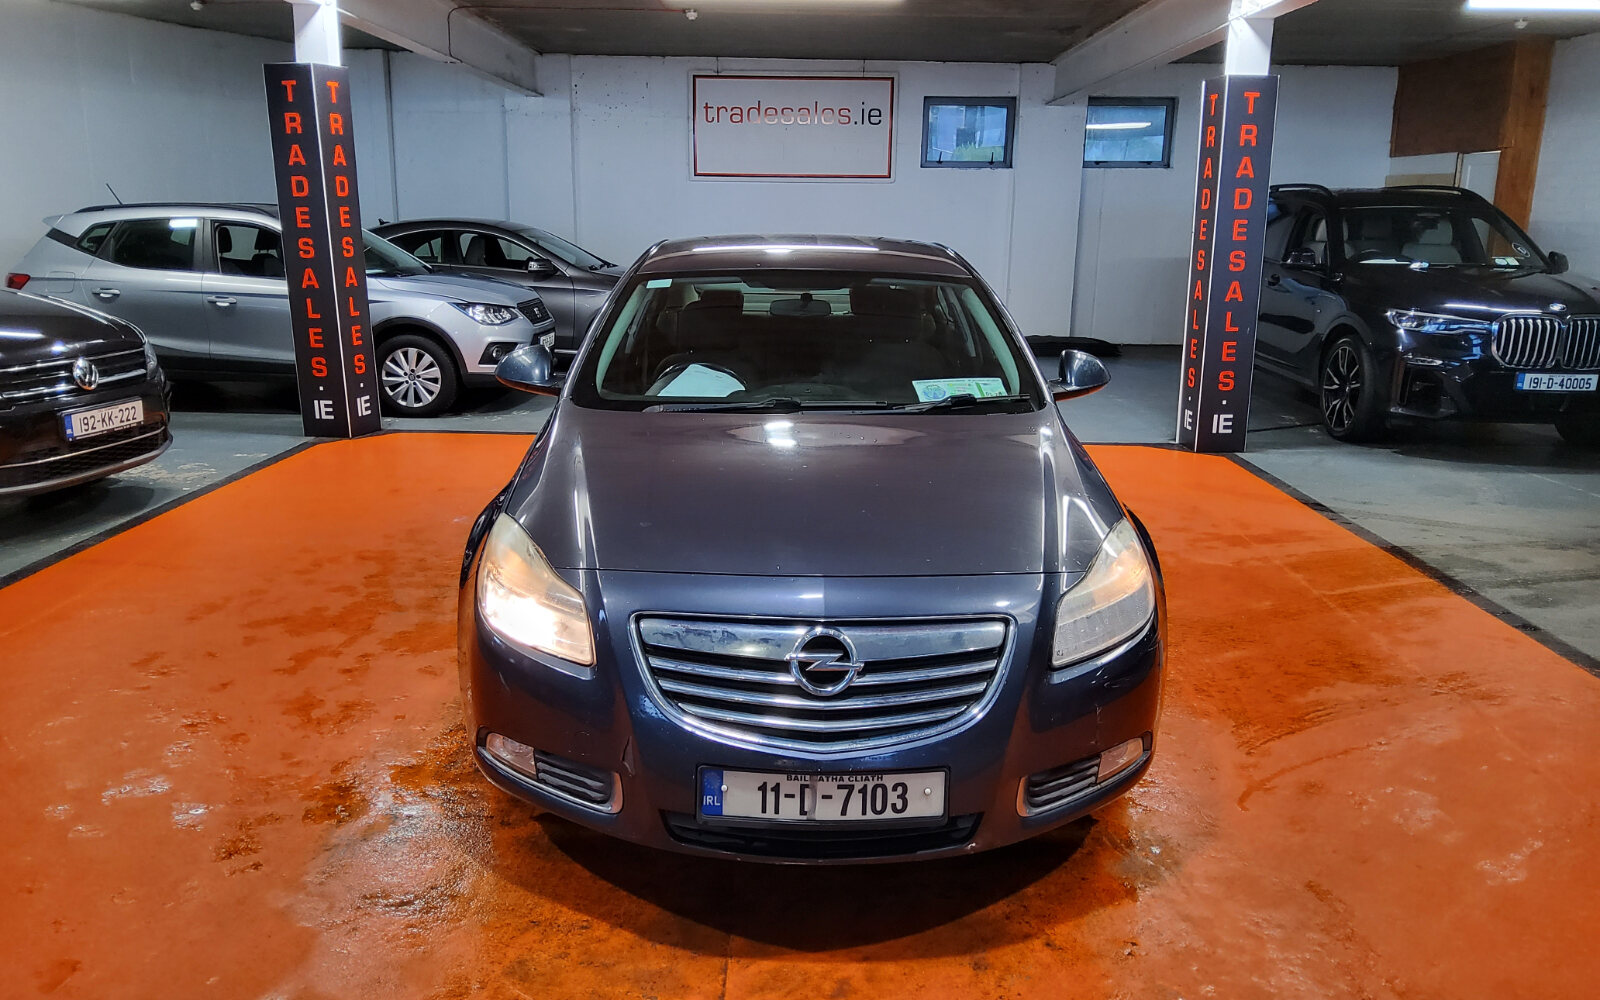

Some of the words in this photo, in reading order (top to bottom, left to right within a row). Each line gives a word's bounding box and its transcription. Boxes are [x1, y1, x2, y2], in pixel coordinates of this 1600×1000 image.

[703, 100, 882, 126] tradesales.ie
[1528, 377, 1593, 390] 191-D-40005
[79, 406, 137, 433] 192-KK-222
[818, 775, 845, 783] ATHA
[847, 774, 884, 783] CLIATH
[703, 795, 721, 806] IRL
